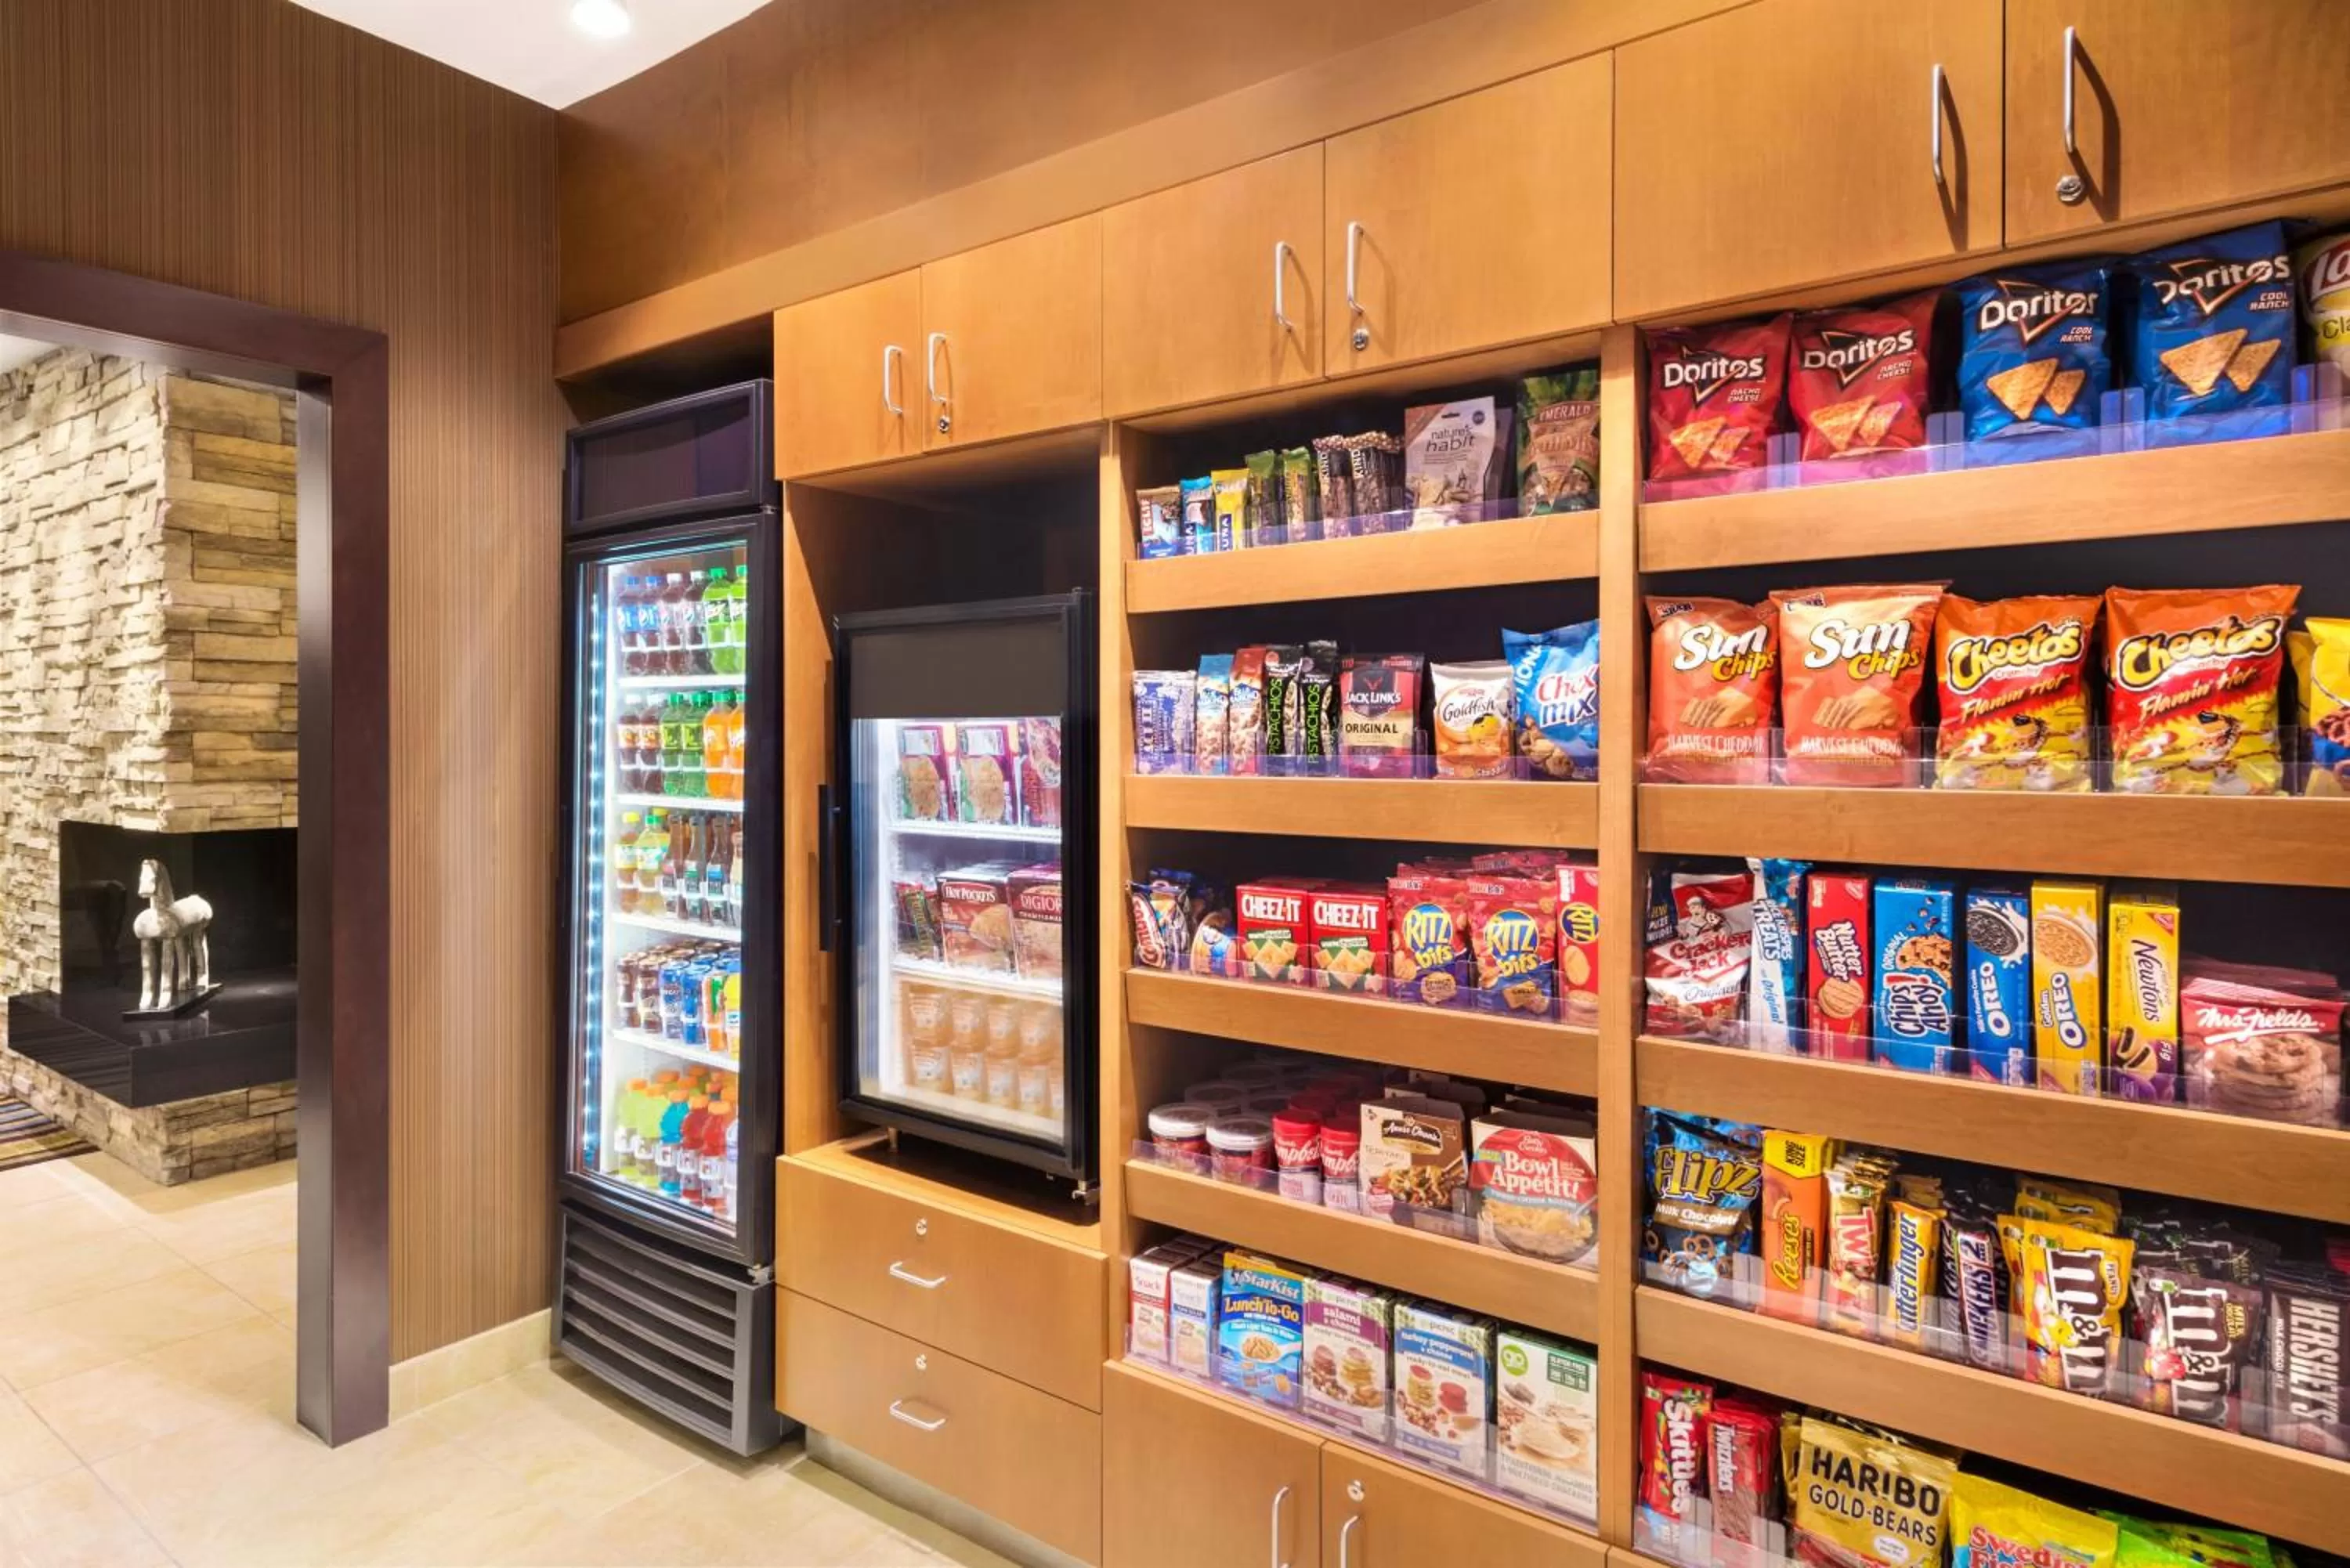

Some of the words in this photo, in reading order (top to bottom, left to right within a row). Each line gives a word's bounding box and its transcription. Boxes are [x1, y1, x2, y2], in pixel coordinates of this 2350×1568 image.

[1980, 291, 2099, 331] Doritos
[2250, 301, 2290, 310] RANCH
[2259, 292, 2288, 302] COOL
[2060, 334, 2093, 343] RANCH
[2070, 326, 2093, 335] COOL
[1803, 330, 1915, 370] Doritos
[1664, 357, 1763, 386] Doritos
[1539, 404, 1592, 421] EMERALD
[1426, 435, 1476, 451] habit
[1320, 452, 1329, 480] KIND
[1352, 449, 1364, 479] KIND
[1221, 517, 1230, 550] UNA
[1673, 623, 1769, 671] Sun
[1804, 619, 1911, 669] Sun
[1950, 623, 2082, 691] Cheetos
[2119, 616, 2282, 689] Cheetos
[1712, 649, 1777, 681] Chips
[1847, 649, 1921, 681] Chips
[2216, 666, 2258, 690] Hot
[1343, 692, 1369, 704] JACK
[1537, 663, 1599, 703] Chex
[2030, 674, 2071, 695] Hot
[1269, 678, 1282, 755] PISTACHIOS
[1306, 683, 1320, 764] PISTACHIOS
[1443, 696, 1495, 722] Goldfish
[1345, 723, 1398, 734] ORIGINAL
[1021, 894, 1062, 914] DIGIO
[1242, 893, 1302, 922] CHEEZ-IT
[1314, 899, 1379, 930] CHEEZ-IT
[1403, 909, 1452, 952] RITZ
[1485, 915, 1536, 956] RITZ
[1567, 905, 1596, 941] RITZ
[1752, 899, 1781, 962] TREATS
[1415, 945, 1454, 970] bits
[1669, 931, 1753, 960] Cracker
[1814, 927, 1850, 982] Butter
[1831, 920, 1864, 978] Nutter
[1882, 931, 1909, 971] ORIGINAL
[1496, 953, 1539, 978] bits
[2130, 938, 2164, 1023] Newtons
[1761, 979, 1786, 1024] Original
[1889, 984, 1926, 1037] Chips
[1979, 960, 2012, 1038] OREO
[2040, 989, 2054, 1028] Golden
[2051, 972, 2087, 1049] OREO
[2237, 1006, 2319, 1042] Fields
[2160, 1040, 2173, 1062] Fig
[1503, 1149, 1560, 1178] Bowl
[1784, 1140, 1796, 1165] KING
[1794, 1144, 1806, 1169] SIZE
[1655, 1202, 1679, 1216] Milk
[1960, 1237, 1980, 1260] 2
[1243, 1270, 1300, 1299] StarKist
[1894, 1212, 1925, 1333] utterfinger
[1224, 1295, 1264, 1313] Lunch
[1663, 1398, 1696, 1514] Skittles
[1811, 1446, 1942, 1517] HARIBO
